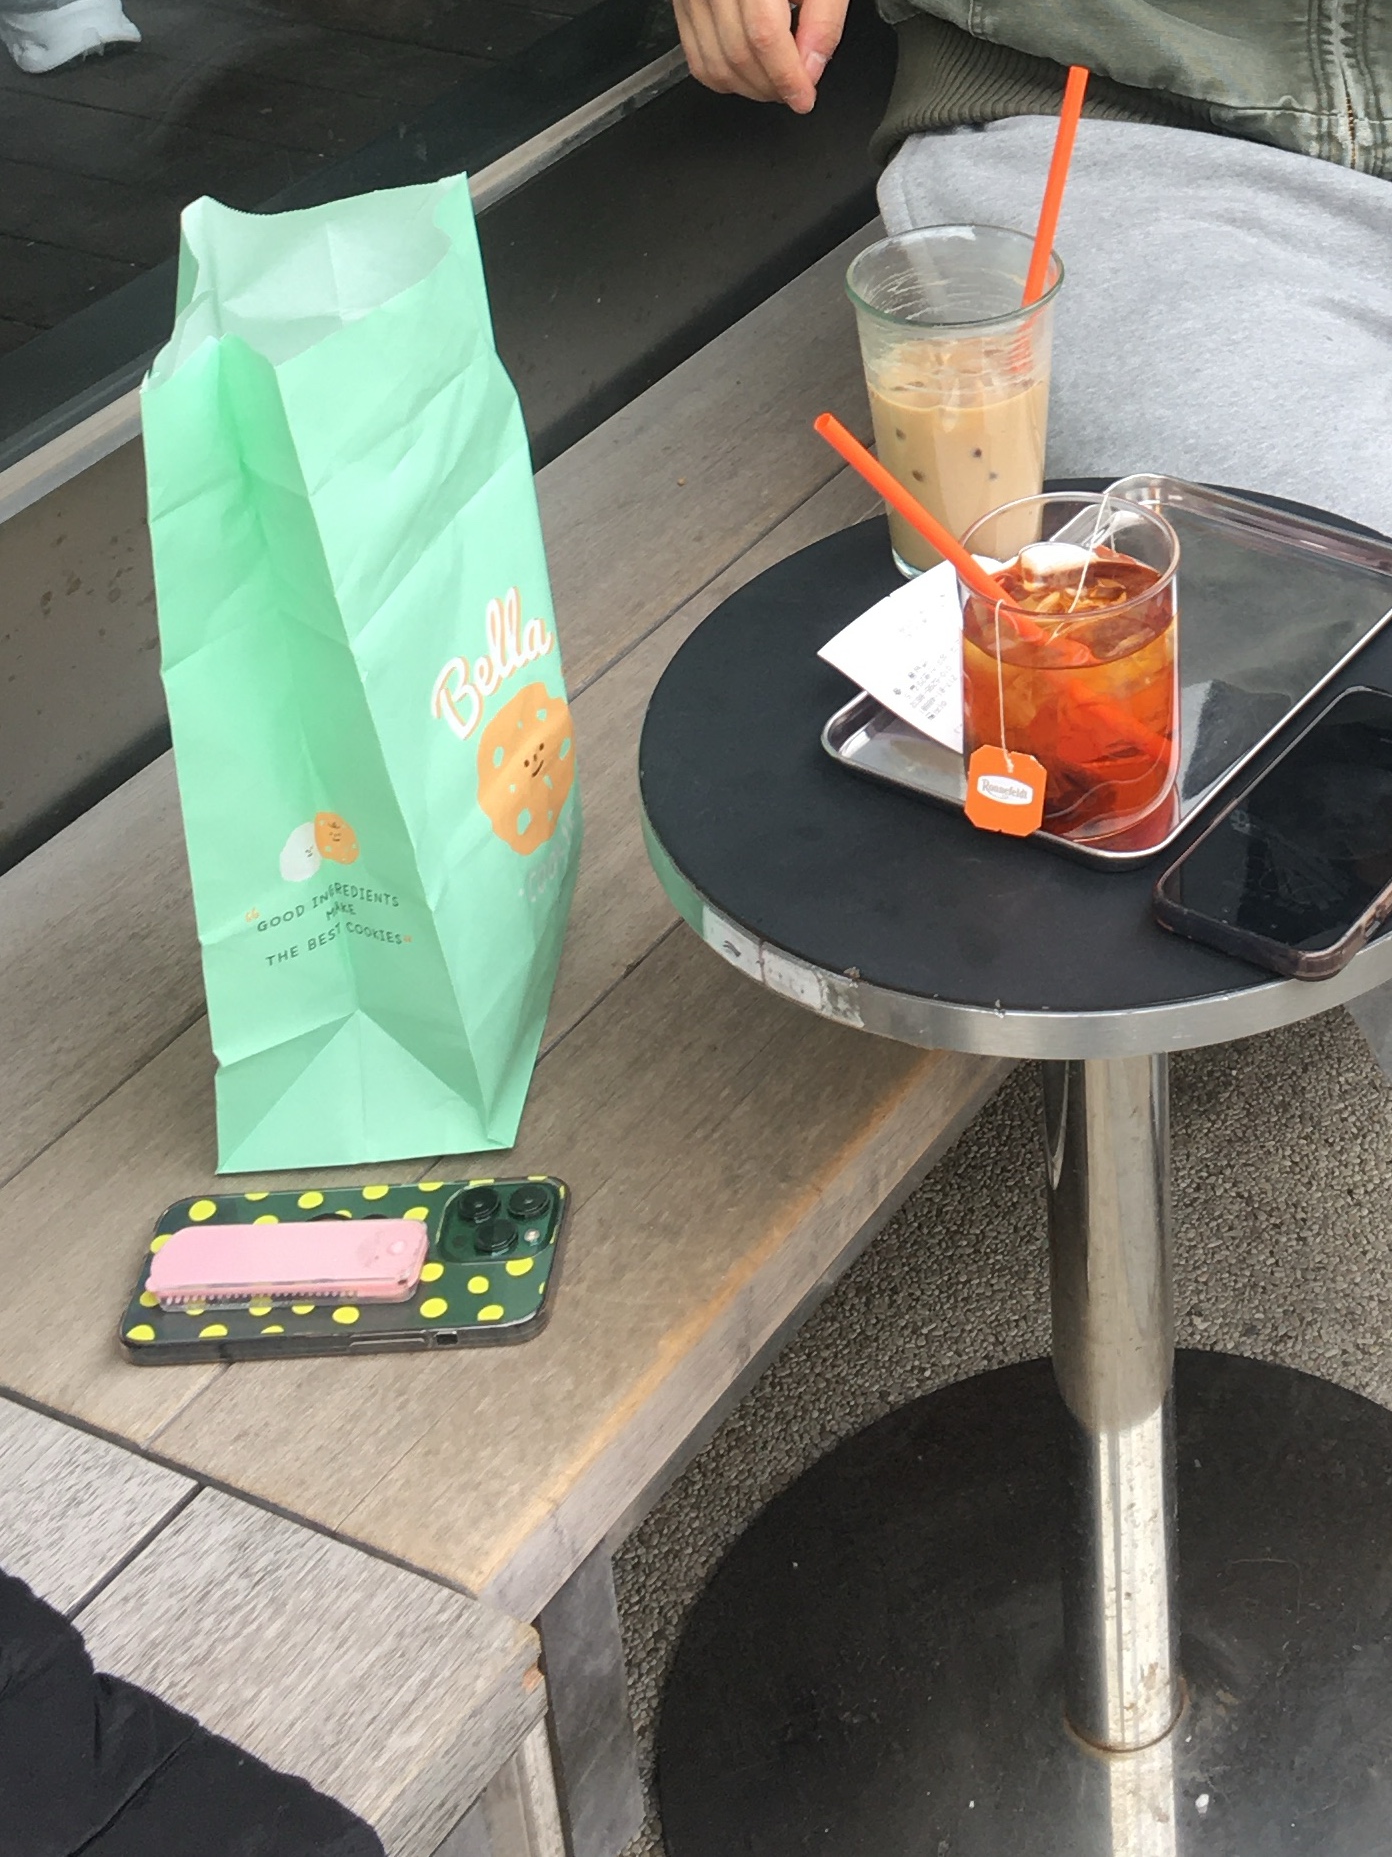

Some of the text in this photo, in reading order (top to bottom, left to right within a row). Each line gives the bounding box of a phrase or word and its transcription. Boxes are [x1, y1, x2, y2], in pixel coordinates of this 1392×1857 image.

[431, 586, 555, 740] Bella
[312, 882, 400, 909] INGREDIENTS
[326, 901, 356, 921] MAKE
[266, 946, 300, 966] THE
[307, 922, 341, 951] BEST
